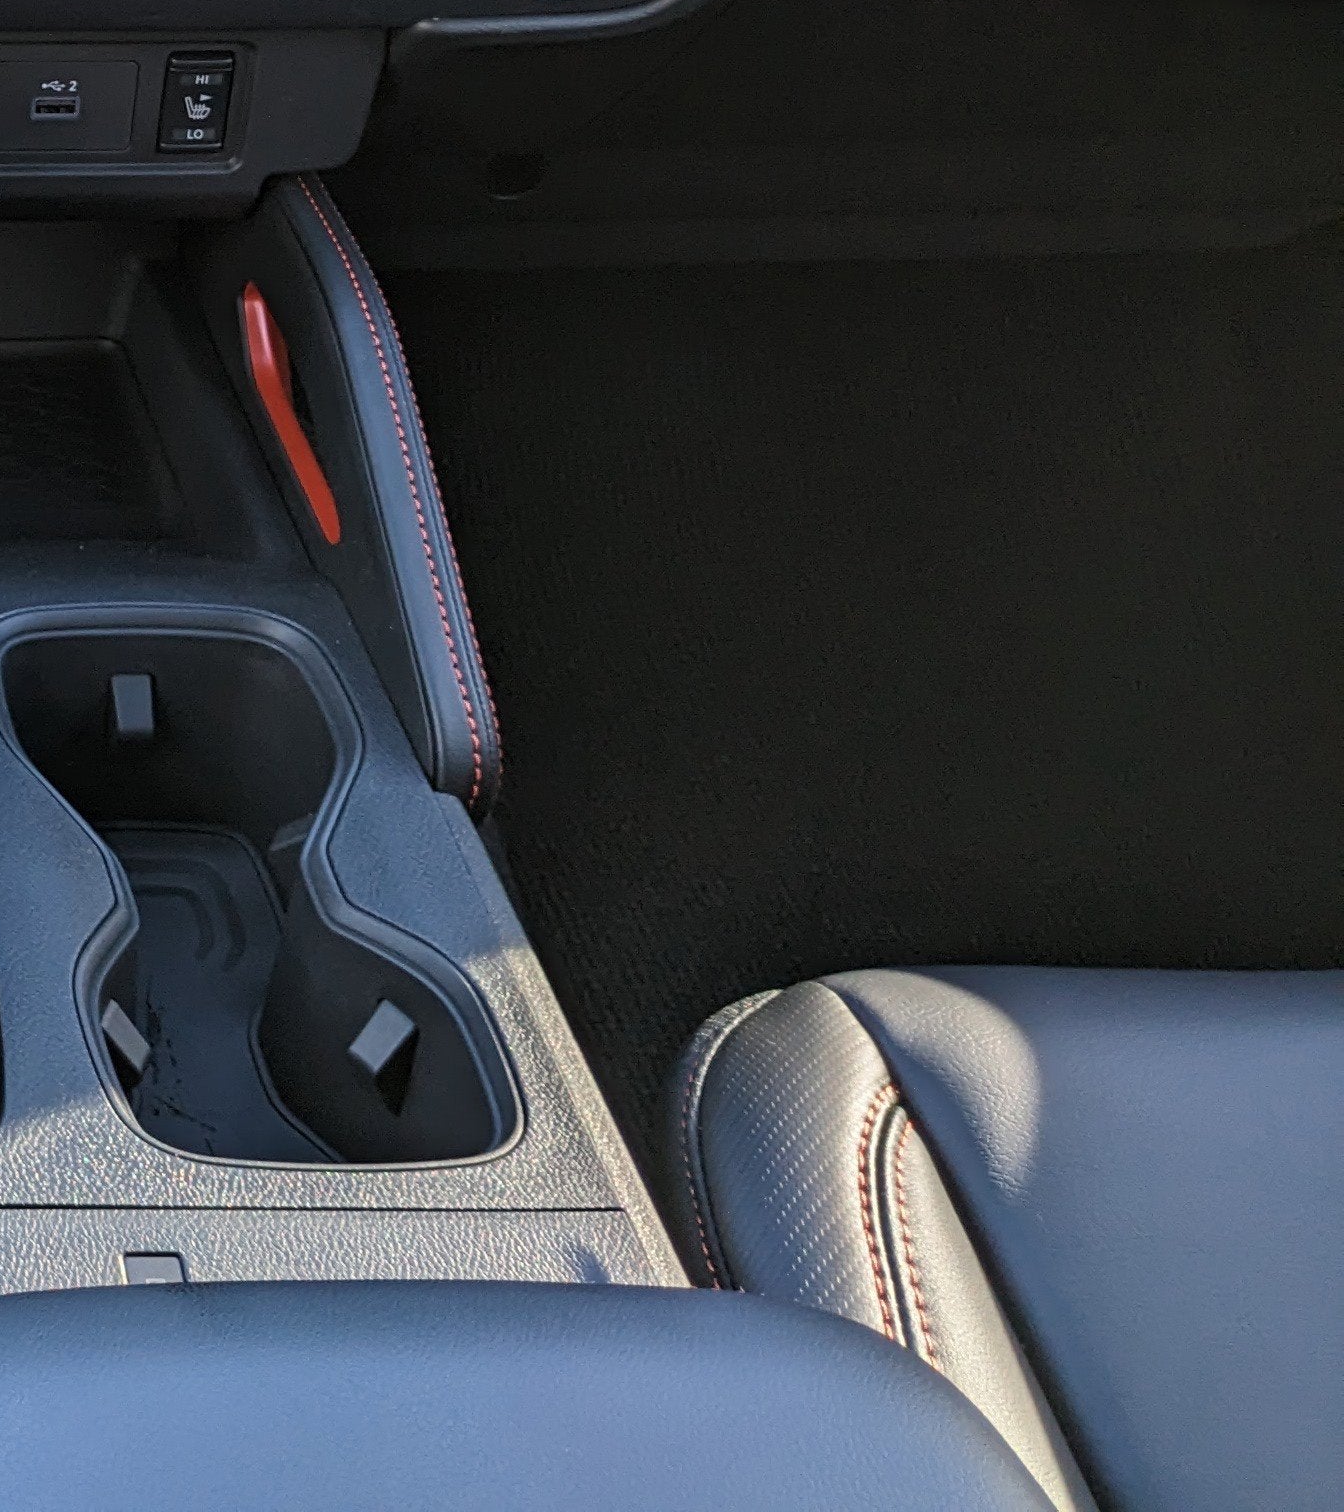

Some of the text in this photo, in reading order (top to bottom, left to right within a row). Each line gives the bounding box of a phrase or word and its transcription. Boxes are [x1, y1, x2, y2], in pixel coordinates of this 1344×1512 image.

[195, 74, 209, 84] HI
[69, 81, 77, 91] 2
[186, 129, 203, 140] LO
